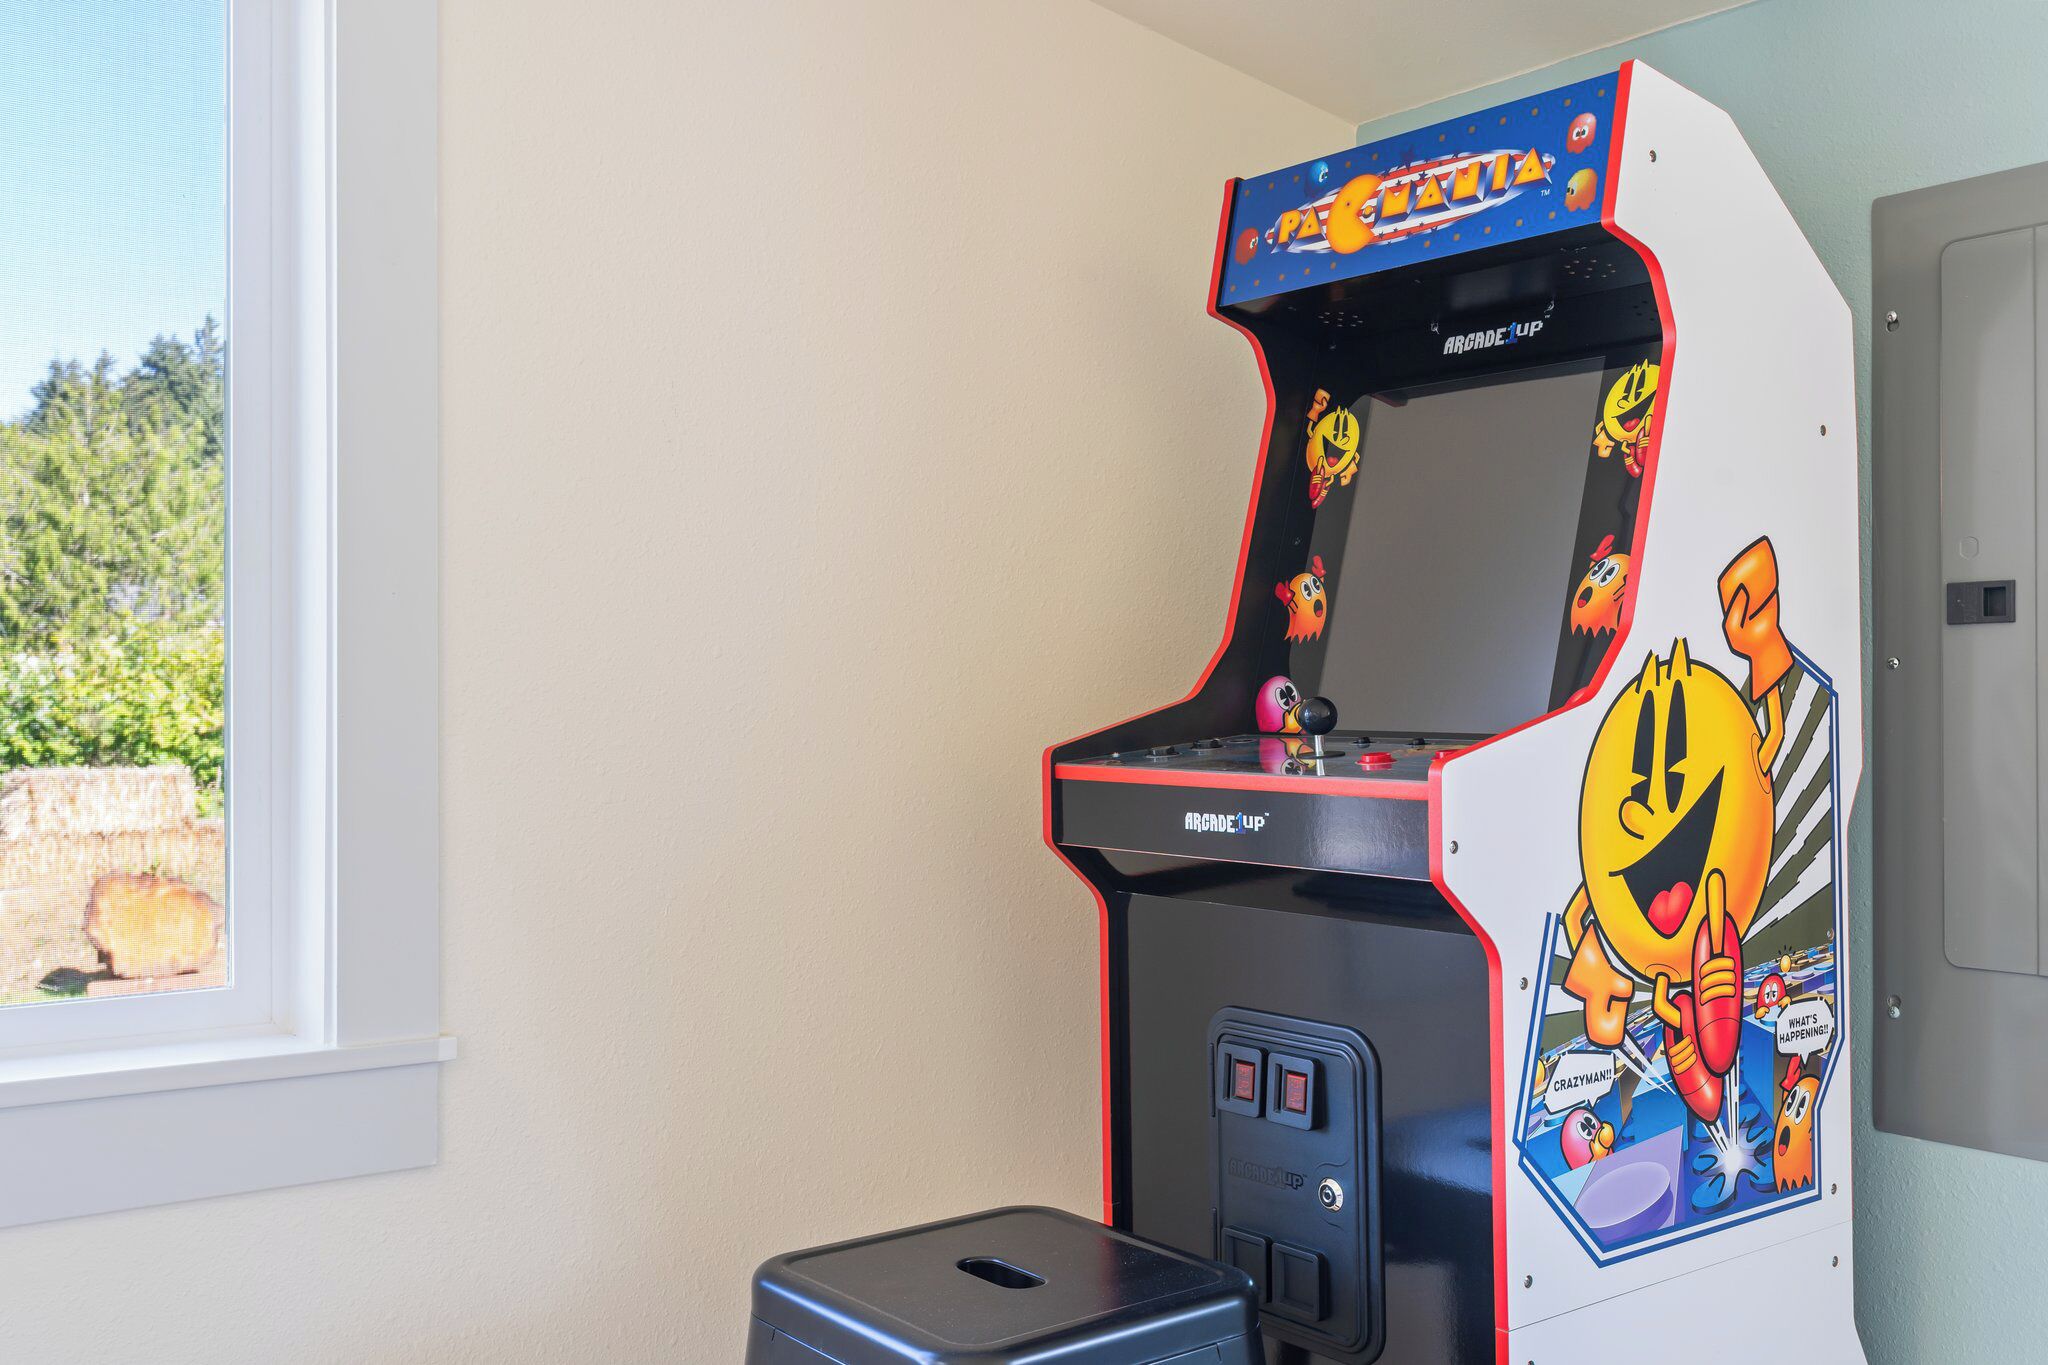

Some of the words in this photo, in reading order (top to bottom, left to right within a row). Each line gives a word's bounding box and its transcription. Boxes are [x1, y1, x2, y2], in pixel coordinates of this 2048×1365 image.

[1789, 1013, 1818, 1029] WHAT'S
[1779, 1024, 1829, 1044] HAPPENING!!
[1553, 1068, 1612, 1092] CRAZYMAN!!
